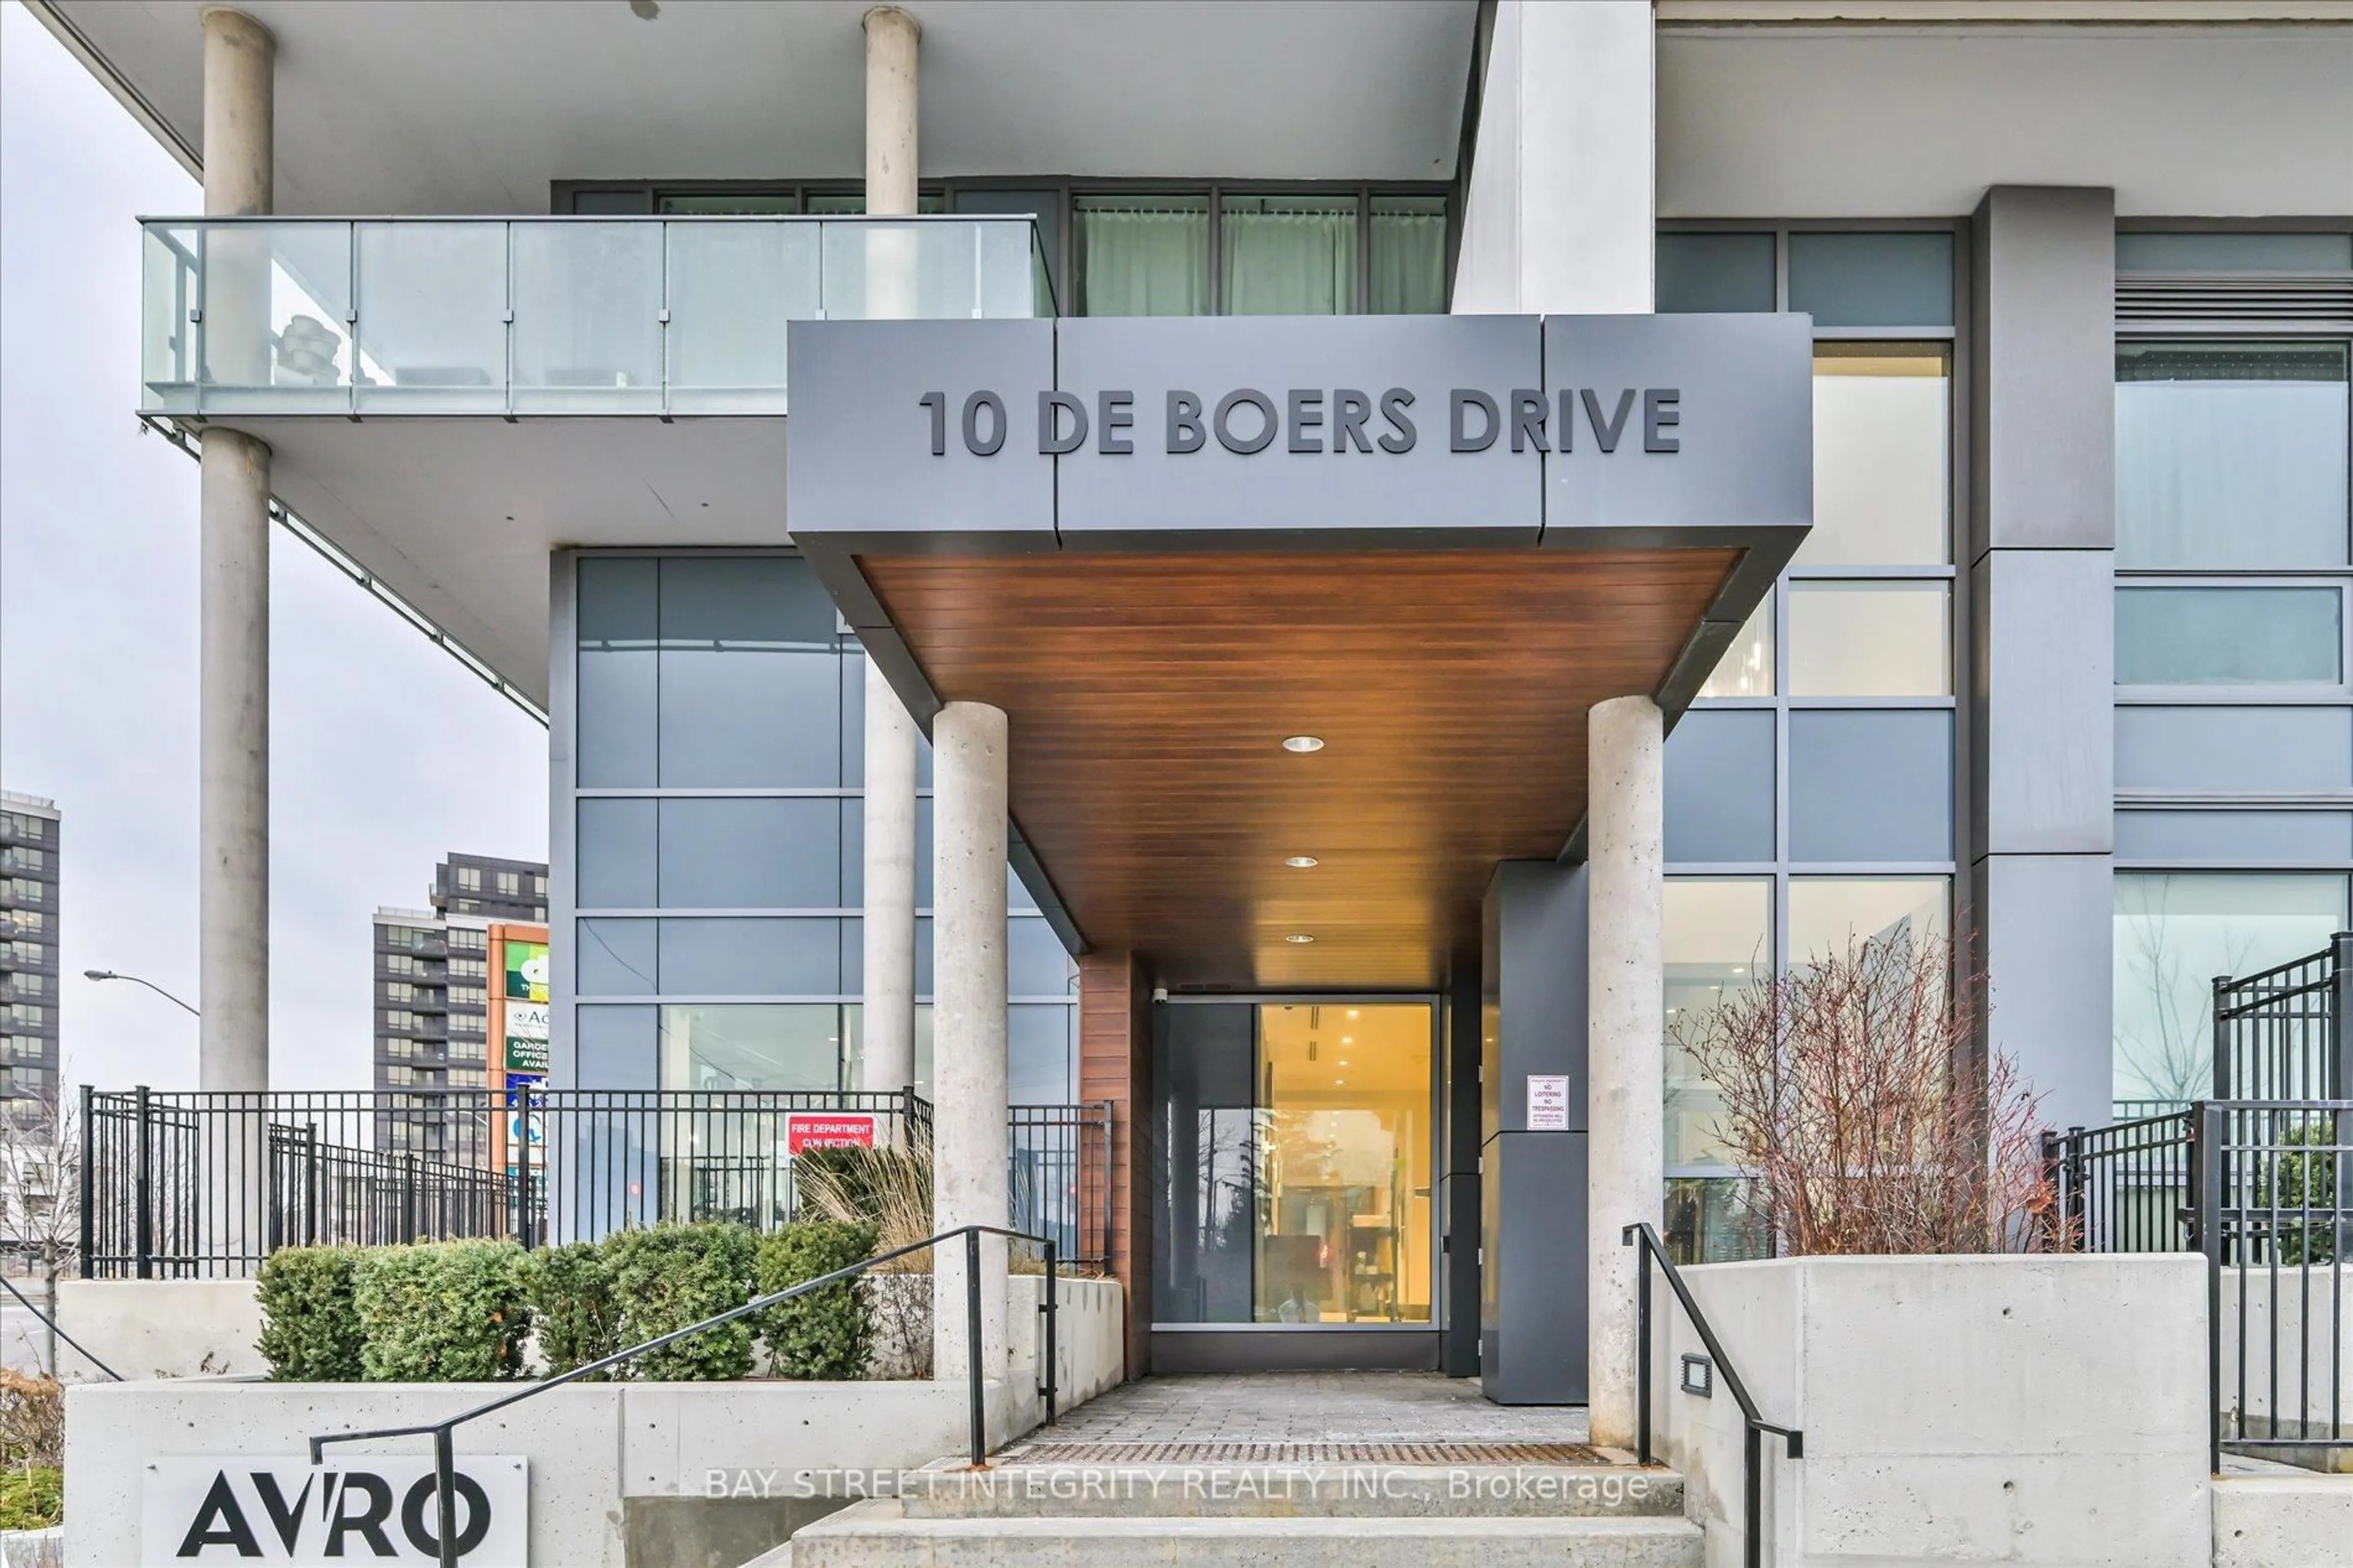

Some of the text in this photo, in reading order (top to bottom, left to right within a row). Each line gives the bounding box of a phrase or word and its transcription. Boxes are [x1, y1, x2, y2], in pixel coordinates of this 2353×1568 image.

[919, 388, 1680, 456] 10 DE BOERS DRIVE
[792, 1124, 870, 1134] FIRE DEPARTMENT
[176, 1468, 491, 1558] AVRO
